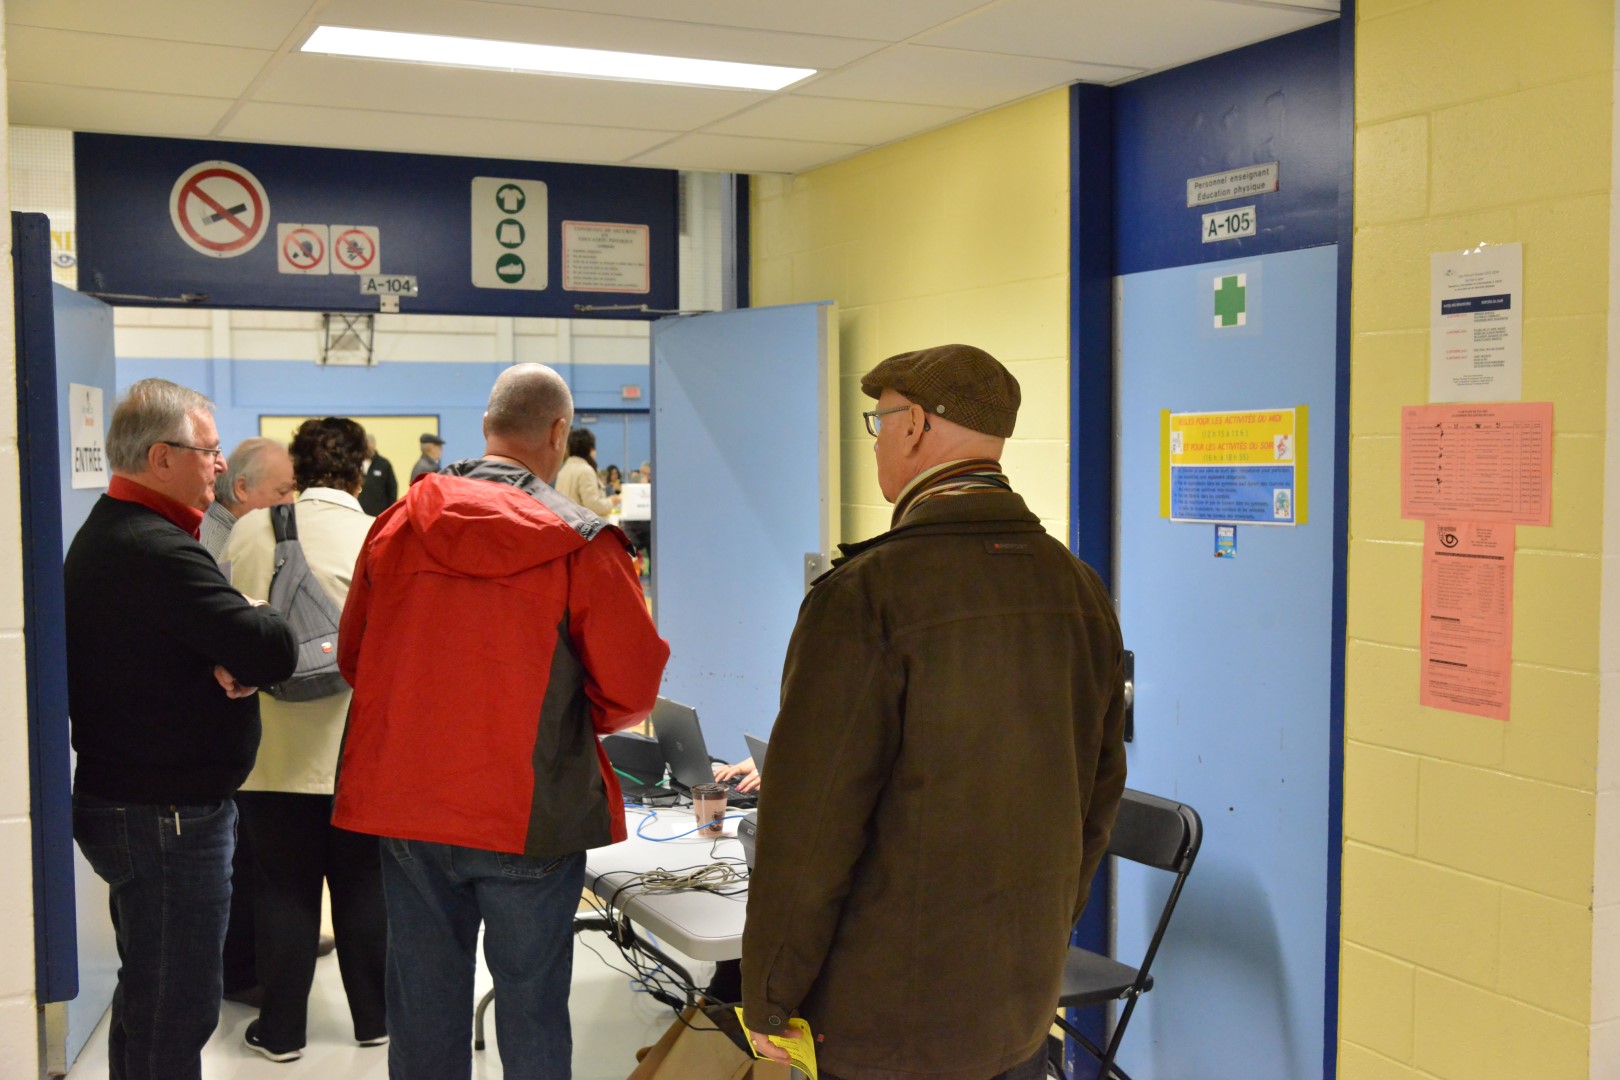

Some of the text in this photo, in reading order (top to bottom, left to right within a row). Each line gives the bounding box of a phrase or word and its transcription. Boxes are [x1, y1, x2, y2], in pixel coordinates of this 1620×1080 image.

[1194, 168, 1270, 189] Personnel enseignant
[1233, 182, 1266, 196] physique
[1208, 212, 1250, 237] A-105
[366, 278, 411, 293] A-104
[1196, 416, 1210, 425] POUR
[1211, 416, 1223, 425] LES
[1224, 414, 1256, 424] ACTIVITÉS
[1257, 414, 1267, 423] DU
[1268, 414, 1283, 423] MIDI
[1190, 443, 1204, 451] POUR
[1205, 442, 1216, 451] LES
[1217, 441, 1248, 450] ACTIVITÉS
[1249, 441, 1258, 450] DU
[1260, 441, 1274, 450] SOIR
[75, 440, 102, 473] ENTRÉE
